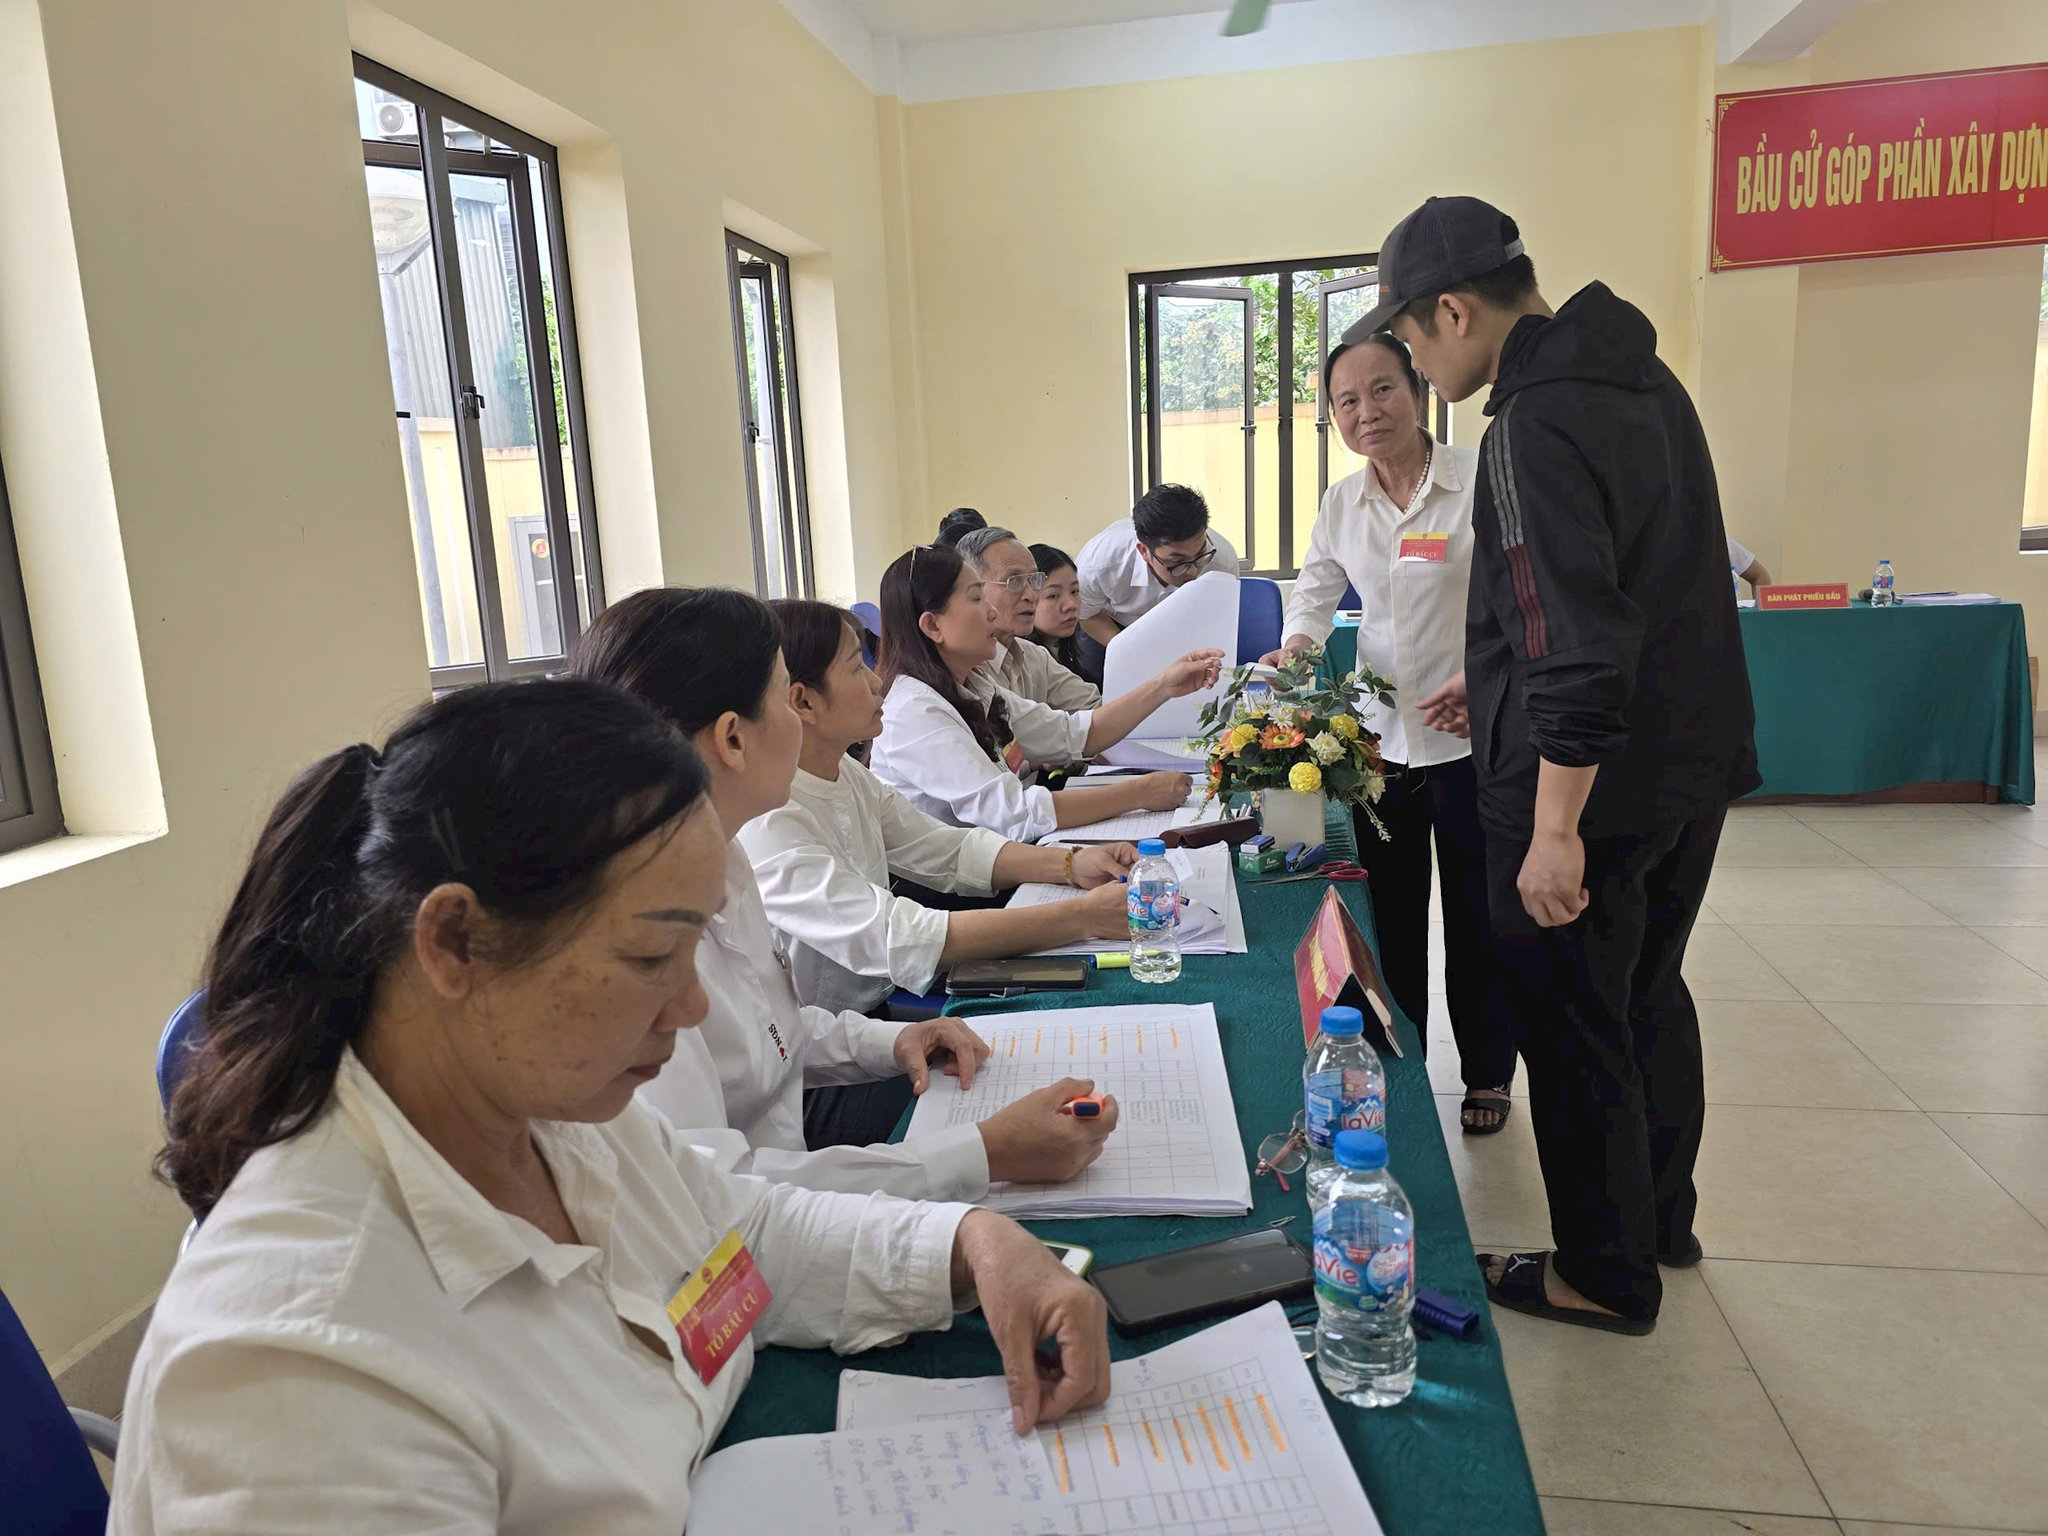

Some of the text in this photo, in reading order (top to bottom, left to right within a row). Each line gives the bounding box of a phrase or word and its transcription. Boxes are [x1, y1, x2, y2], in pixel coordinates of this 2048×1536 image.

[1736, 133, 1783, 214] BẦU
[1789, 128, 1823, 210] CỬ
[1825, 132, 1872, 206] GÓP
[1877, 117, 1942, 202] PHẦN
[1946, 121, 1995, 196] XÂY
[1767, 593, 1783, 602] BÀN
[1783, 592, 1802, 601] PHÁT
[721, 1308, 745, 1338] BẦU
